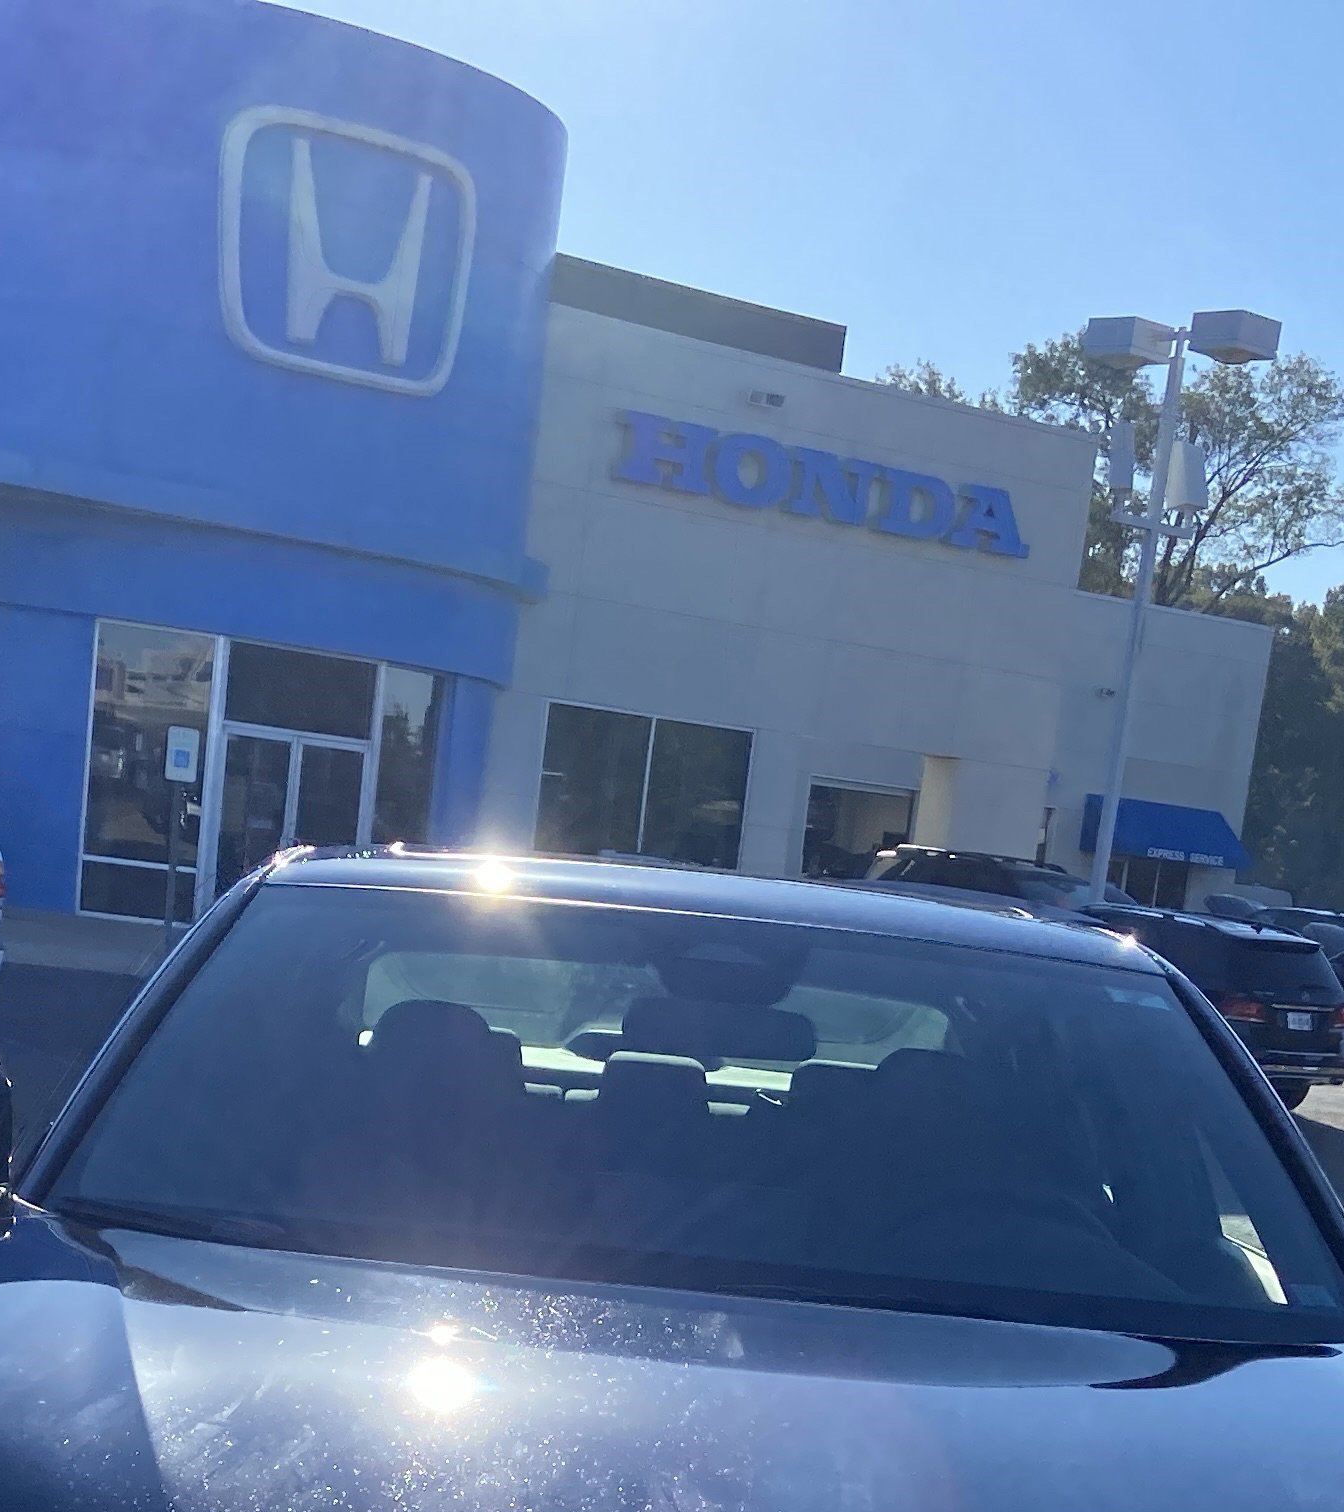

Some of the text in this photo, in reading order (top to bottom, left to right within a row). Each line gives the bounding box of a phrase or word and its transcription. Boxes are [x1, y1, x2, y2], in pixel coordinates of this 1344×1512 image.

[613, 409, 1030, 560] HONDA
[1147, 847, 1224, 866] EXPRESS SERVICE
